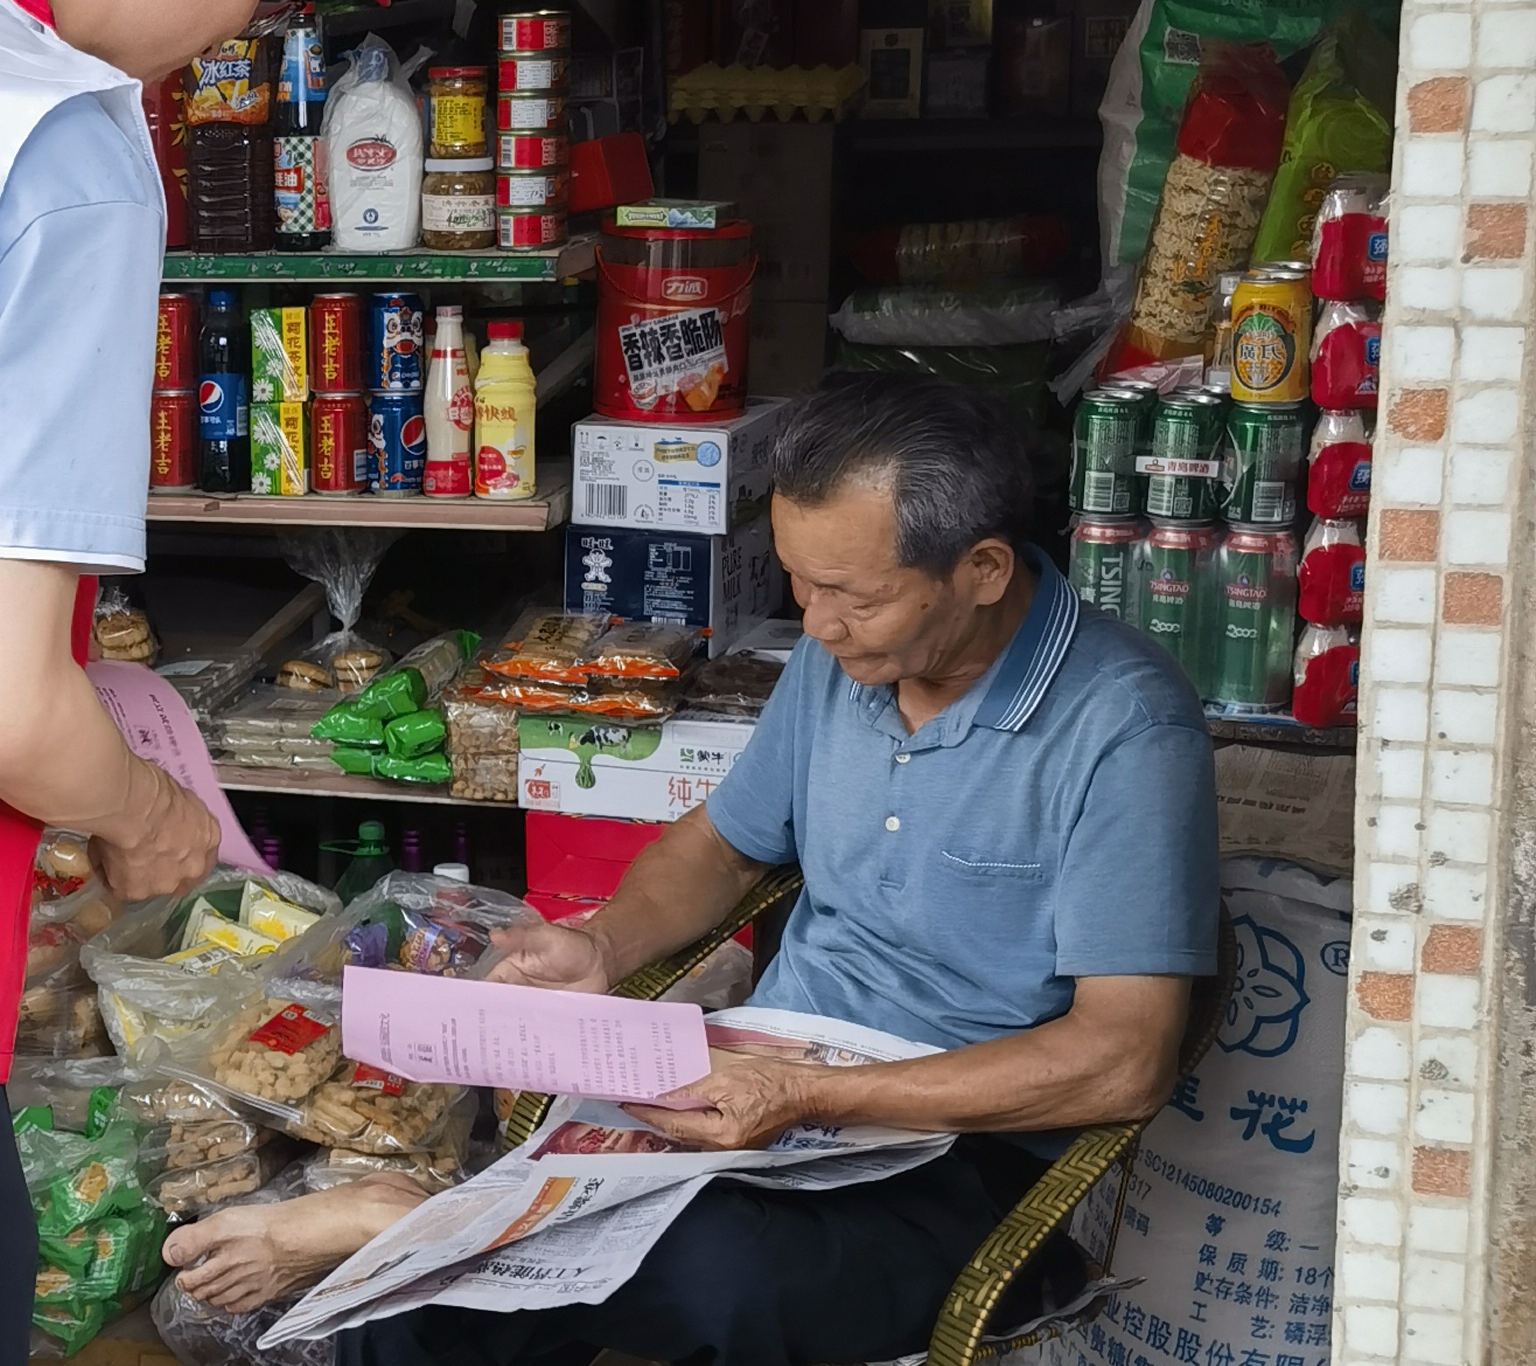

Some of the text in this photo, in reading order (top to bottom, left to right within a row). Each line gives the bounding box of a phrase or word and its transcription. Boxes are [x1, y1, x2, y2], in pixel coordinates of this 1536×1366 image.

[200, 59, 252, 87] 冰红茶
[323, 311, 340, 381] 王老吉
[622, 309, 724, 372] 香辣香脆肠
[154, 410, 172, 476] 王老吉
[317, 415, 335, 481] 王老吉
[1149, 581, 1190, 594] TSINGTAO
[1225, 586, 1267, 599] TSINGTAO
